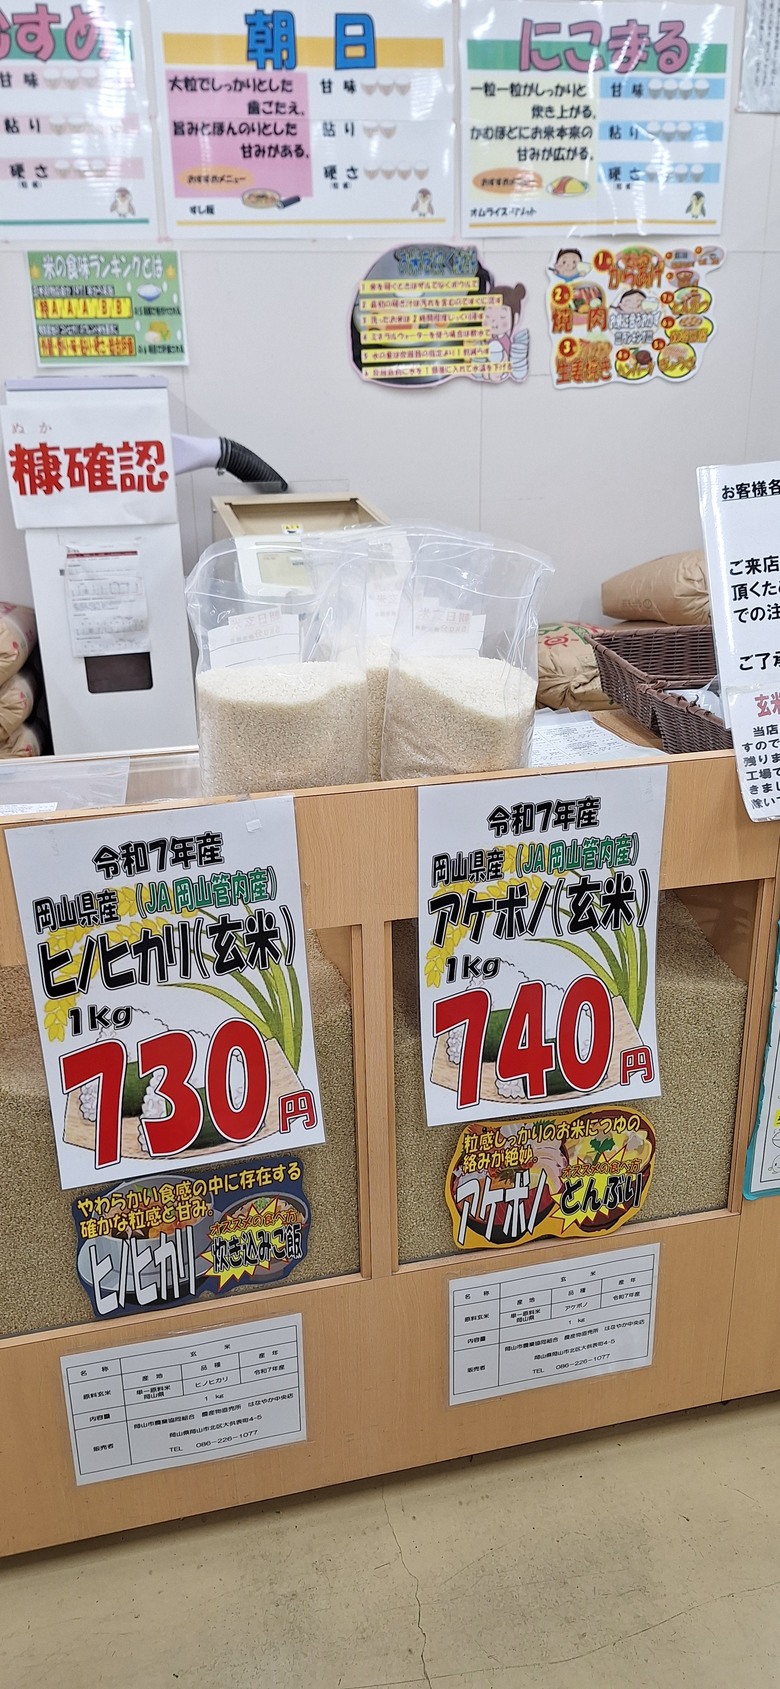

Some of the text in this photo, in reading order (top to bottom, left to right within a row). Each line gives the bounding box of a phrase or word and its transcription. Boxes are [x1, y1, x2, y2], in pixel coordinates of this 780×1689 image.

[519, 18, 690, 74] にこまる
[168, 77, 294, 93] 大粒でしっかりとした
[321, 79, 357, 94] 甘味
[471, 82, 587, 98] 一粒一粒がしっかりと
[611, 83, 644, 98] 甘味
[173, 121, 298, 138] 旨みとほんのりとした
[470, 125, 593, 140] かむほどにお米本来の
[9, 440, 169, 496] 糠確認
[730, 555, 780, 576] ご来店
[731, 580, 780, 601] 頂くた
[734, 603, 780, 623] での注
[753, 725, 779, 738] 当店
[742, 738, 780, 752] すので
[487, 796, 601, 837] 令和7年産
[92, 831, 225, 880] 令和7年産
[431, 846, 505, 887] 岡山県産
[34, 888, 121, 934] 岡山県産
[464, 1114, 641, 1152] 粒感しっかりのお米につゆの
[463, 1146, 538, 1173] 絡みが絶妙。
[562, 1158, 642, 1178] オススメの食べ方
[78, 1162, 301, 1217] やわらかい食感の中に存在する
[456, 1168, 548, 1245] アケボノ
[80, 1201, 214, 1239] 確かな粒感と甘み。
[210, 1209, 297, 1235] オススメの食べ方
[212, 1223, 303, 1273] 炊き込みご飯
[88, 1225, 196, 1315] ヒノヒカリ
[565, 1302, 588, 1311] アケボノ
[613, 1291, 640, 1301] 令和7年産
[195, 1376, 229, 1388] ヒノヒカリ
[254, 1364, 285, 1376] 令和7年産
[247, 1393, 294, 1407] はなやか中央店
